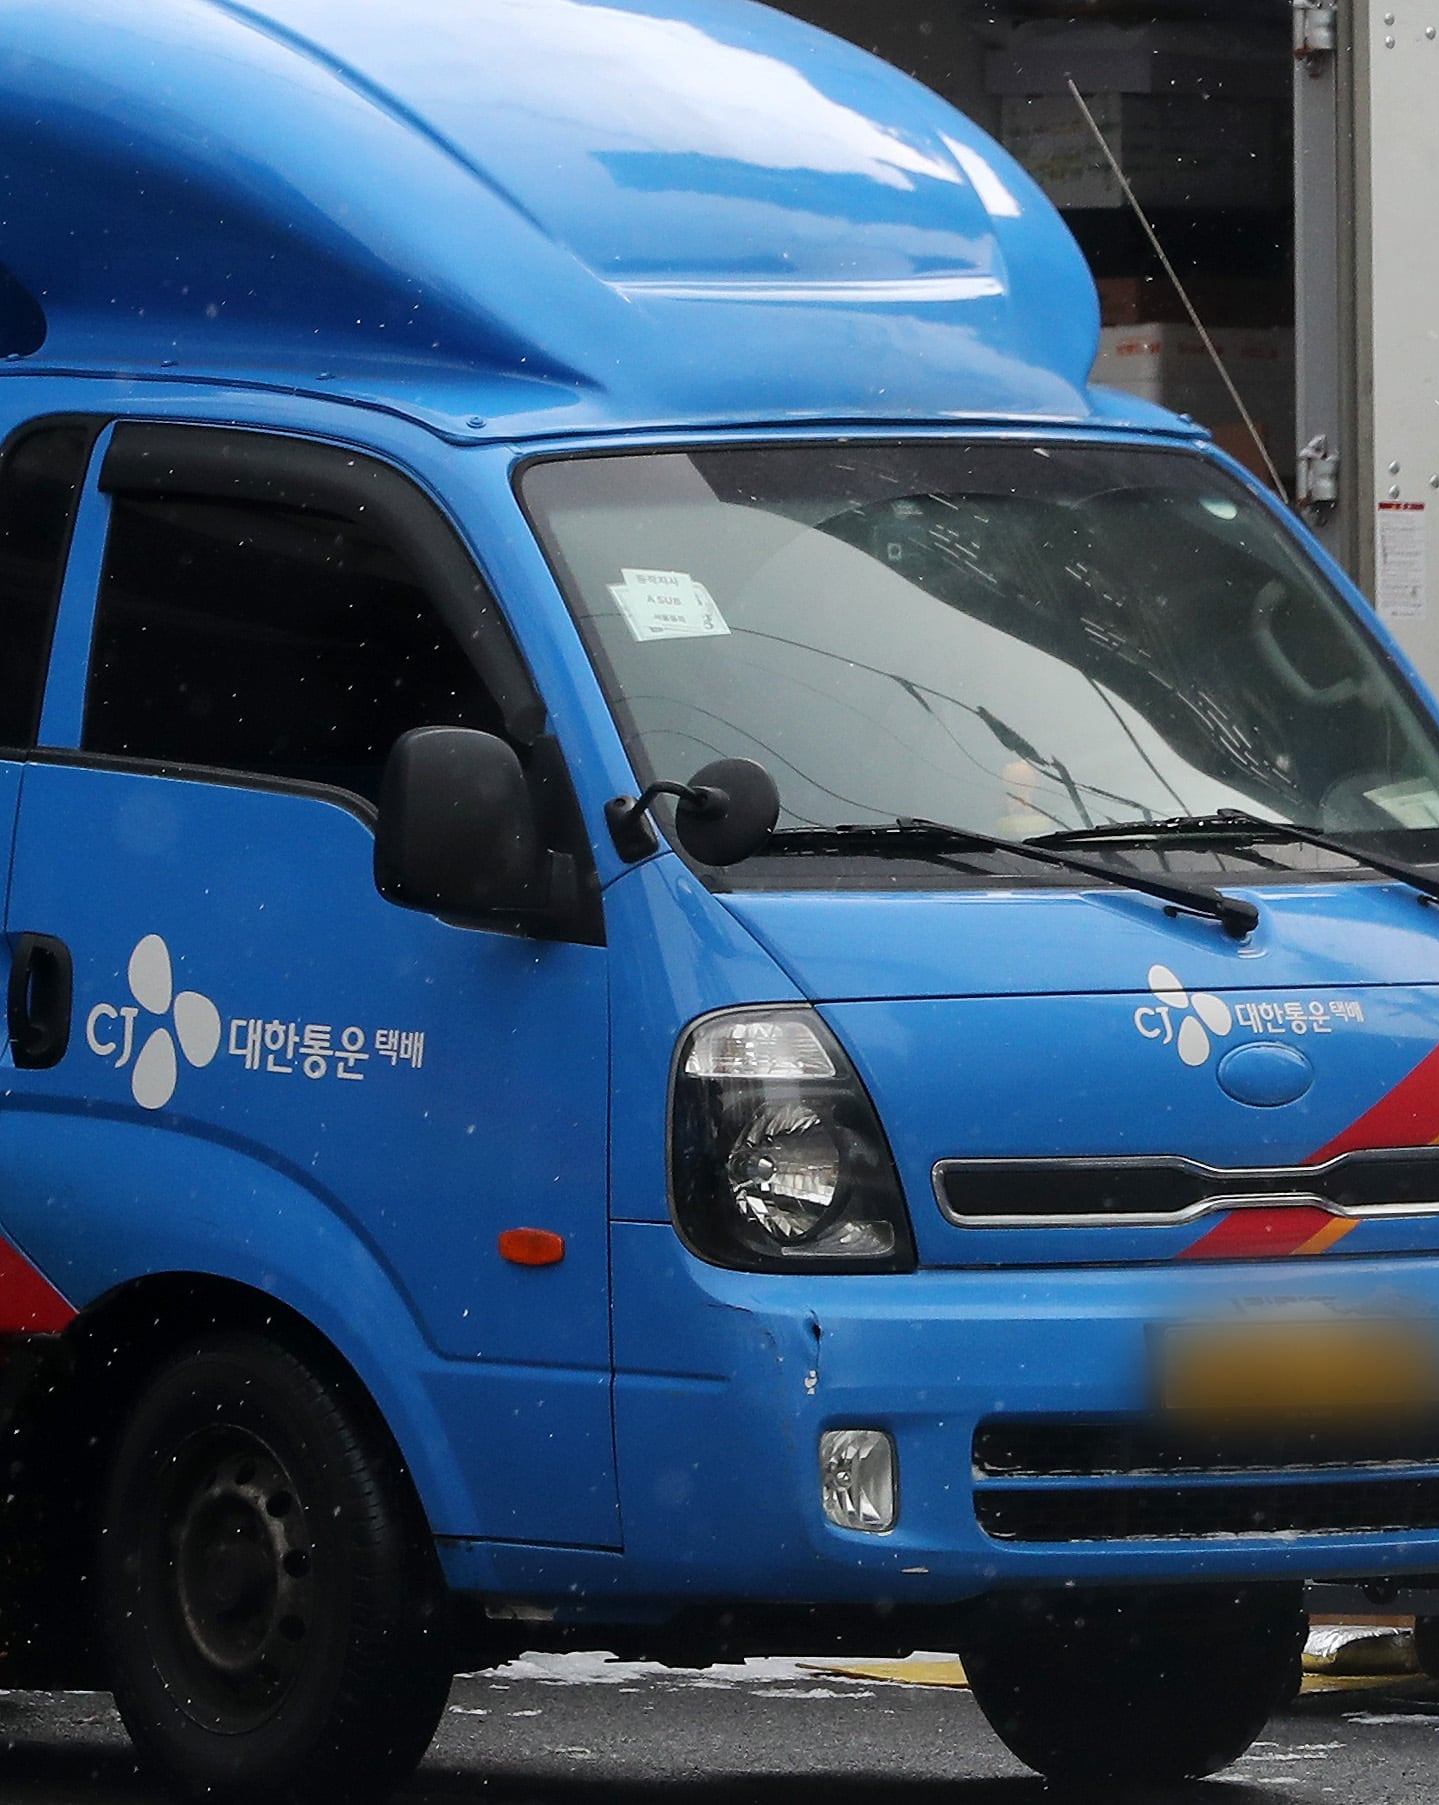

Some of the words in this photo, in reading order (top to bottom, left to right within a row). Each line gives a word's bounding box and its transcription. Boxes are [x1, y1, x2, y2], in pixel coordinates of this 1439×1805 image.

[86, 1002, 139, 1069] CJ
[1133, 1005, 1174, 1045] CJ
[1233, 1001, 1333, 1035] 대한통운
[1329, 1000, 1366, 1023] 택배
[228, 1018, 370, 1081] 대한통운
[374, 1028, 426, 1069] 택배
